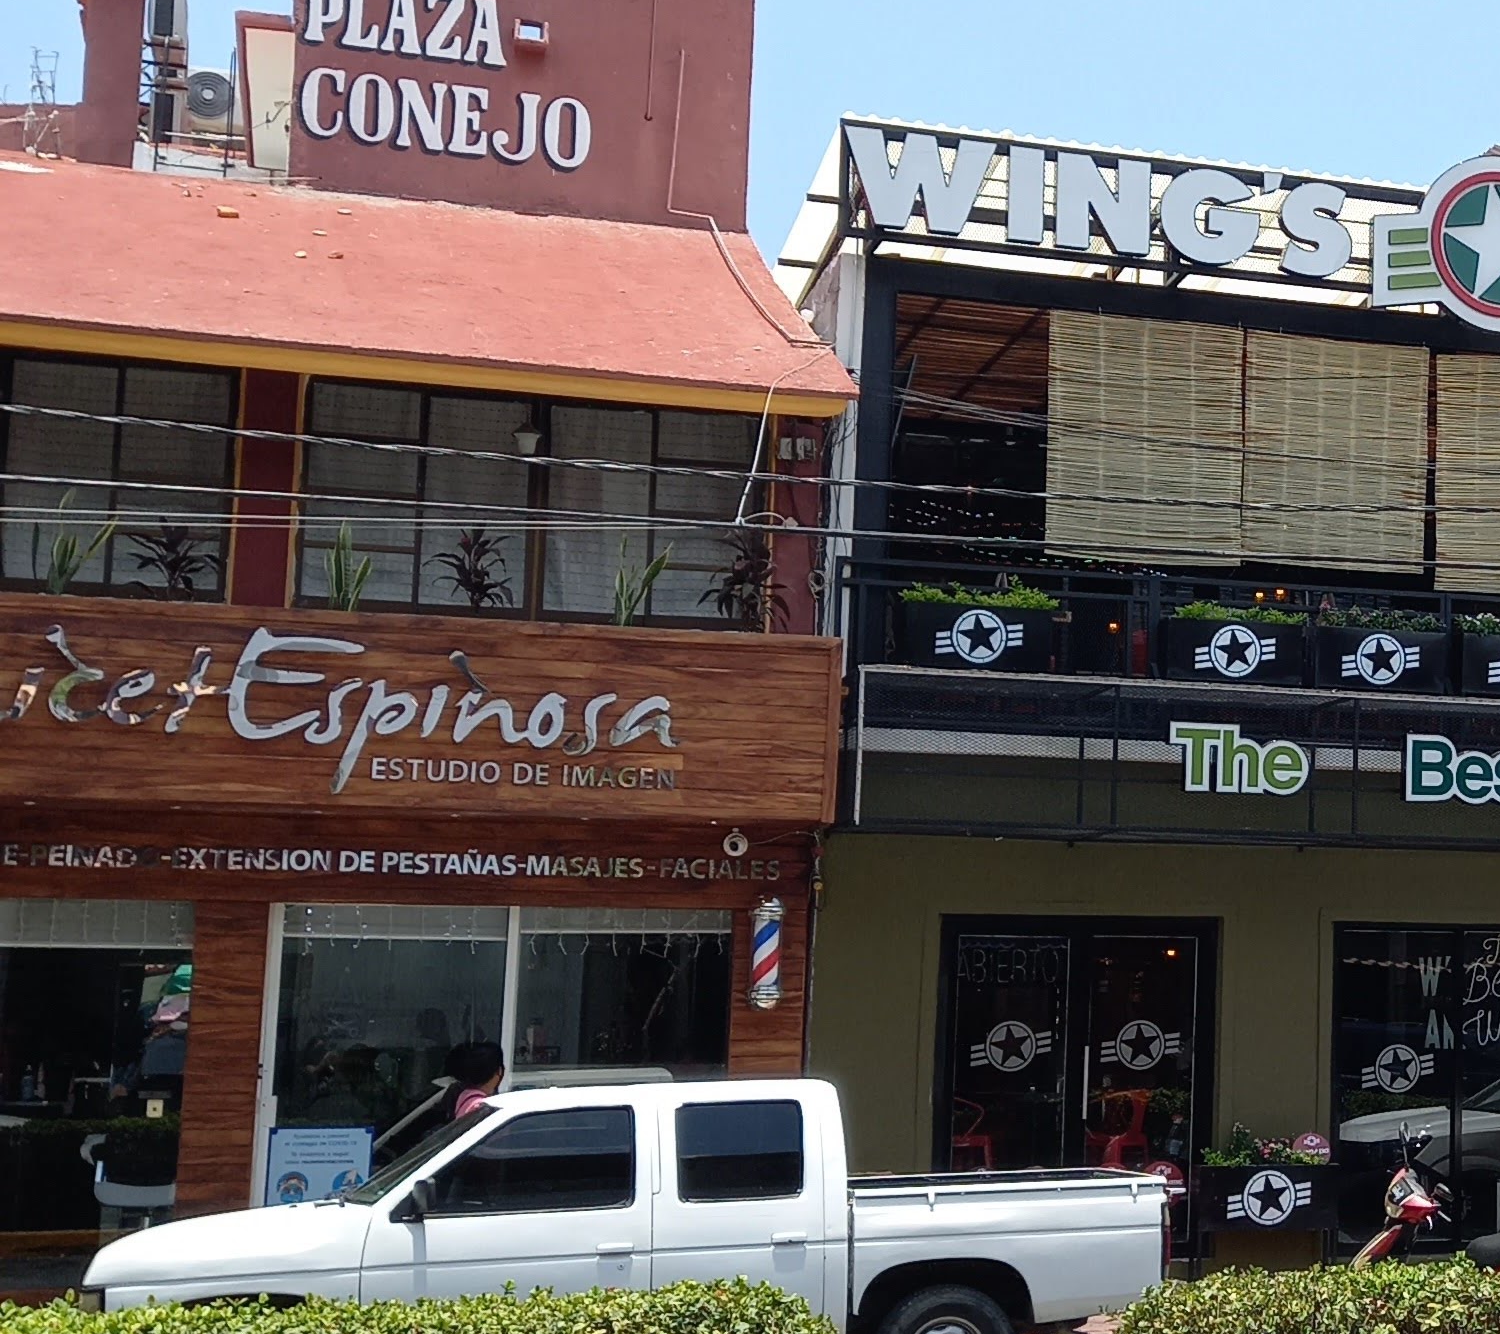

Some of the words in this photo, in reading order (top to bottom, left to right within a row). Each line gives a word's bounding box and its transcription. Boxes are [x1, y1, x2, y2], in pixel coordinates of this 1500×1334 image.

[301, 67, 592, 168] CONEJO
[843, 124, 1353, 278] WING'S
[228, 626, 682, 795] Espinosa
[371, 755, 501, 785] ESTUDIO
[512, 762, 550, 787] DE
[562, 763, 676, 791] IMAGEN
[1173, 725, 1305, 793] The
[338, 849, 376, 874] DE
[957, 948, 1060, 984] ABIERTO
